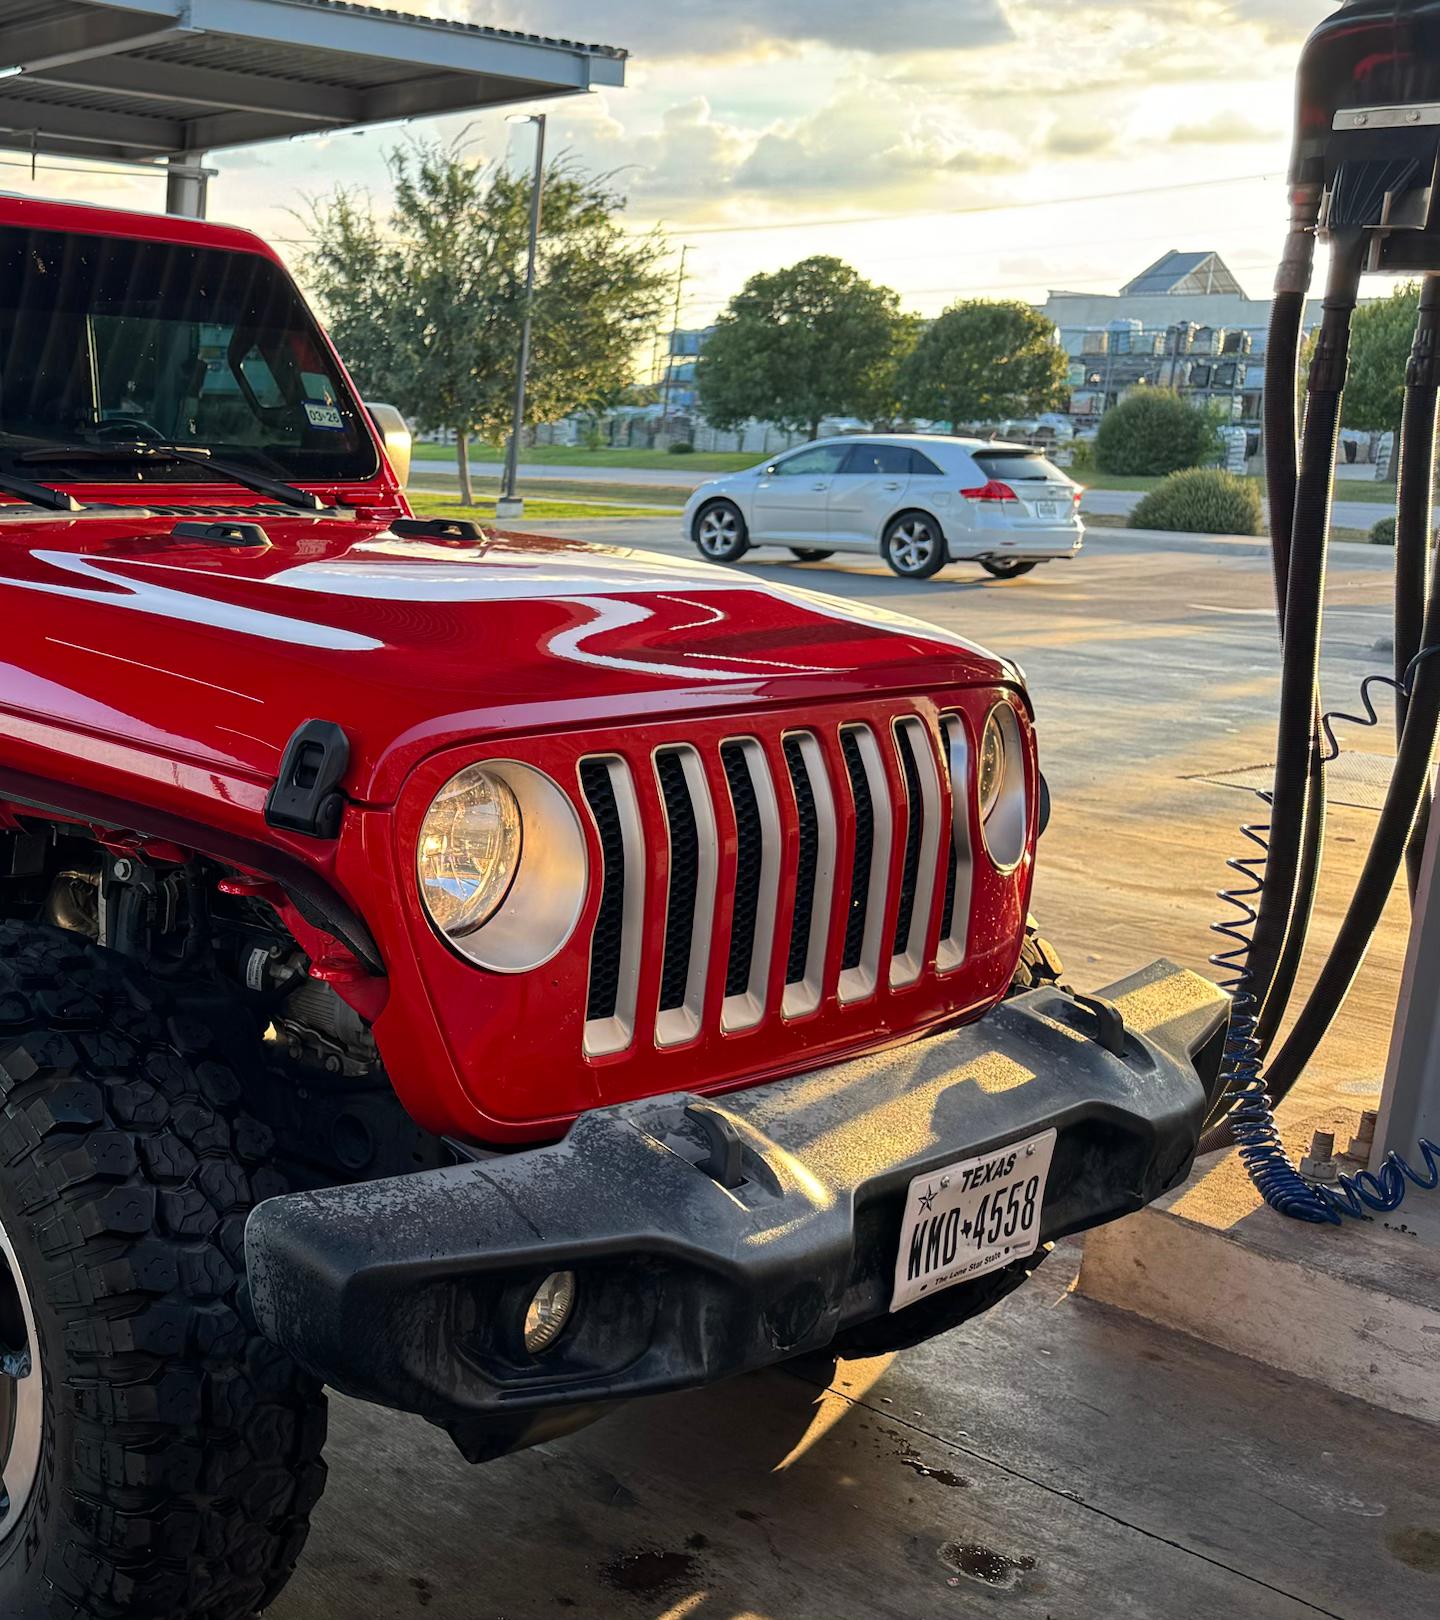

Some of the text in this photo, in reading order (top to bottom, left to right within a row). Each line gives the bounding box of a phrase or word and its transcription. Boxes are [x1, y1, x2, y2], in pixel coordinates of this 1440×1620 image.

[961, 1153, 1017, 1193] TEXAS
[934, 1250, 1001, 1286] The Lone Star State
